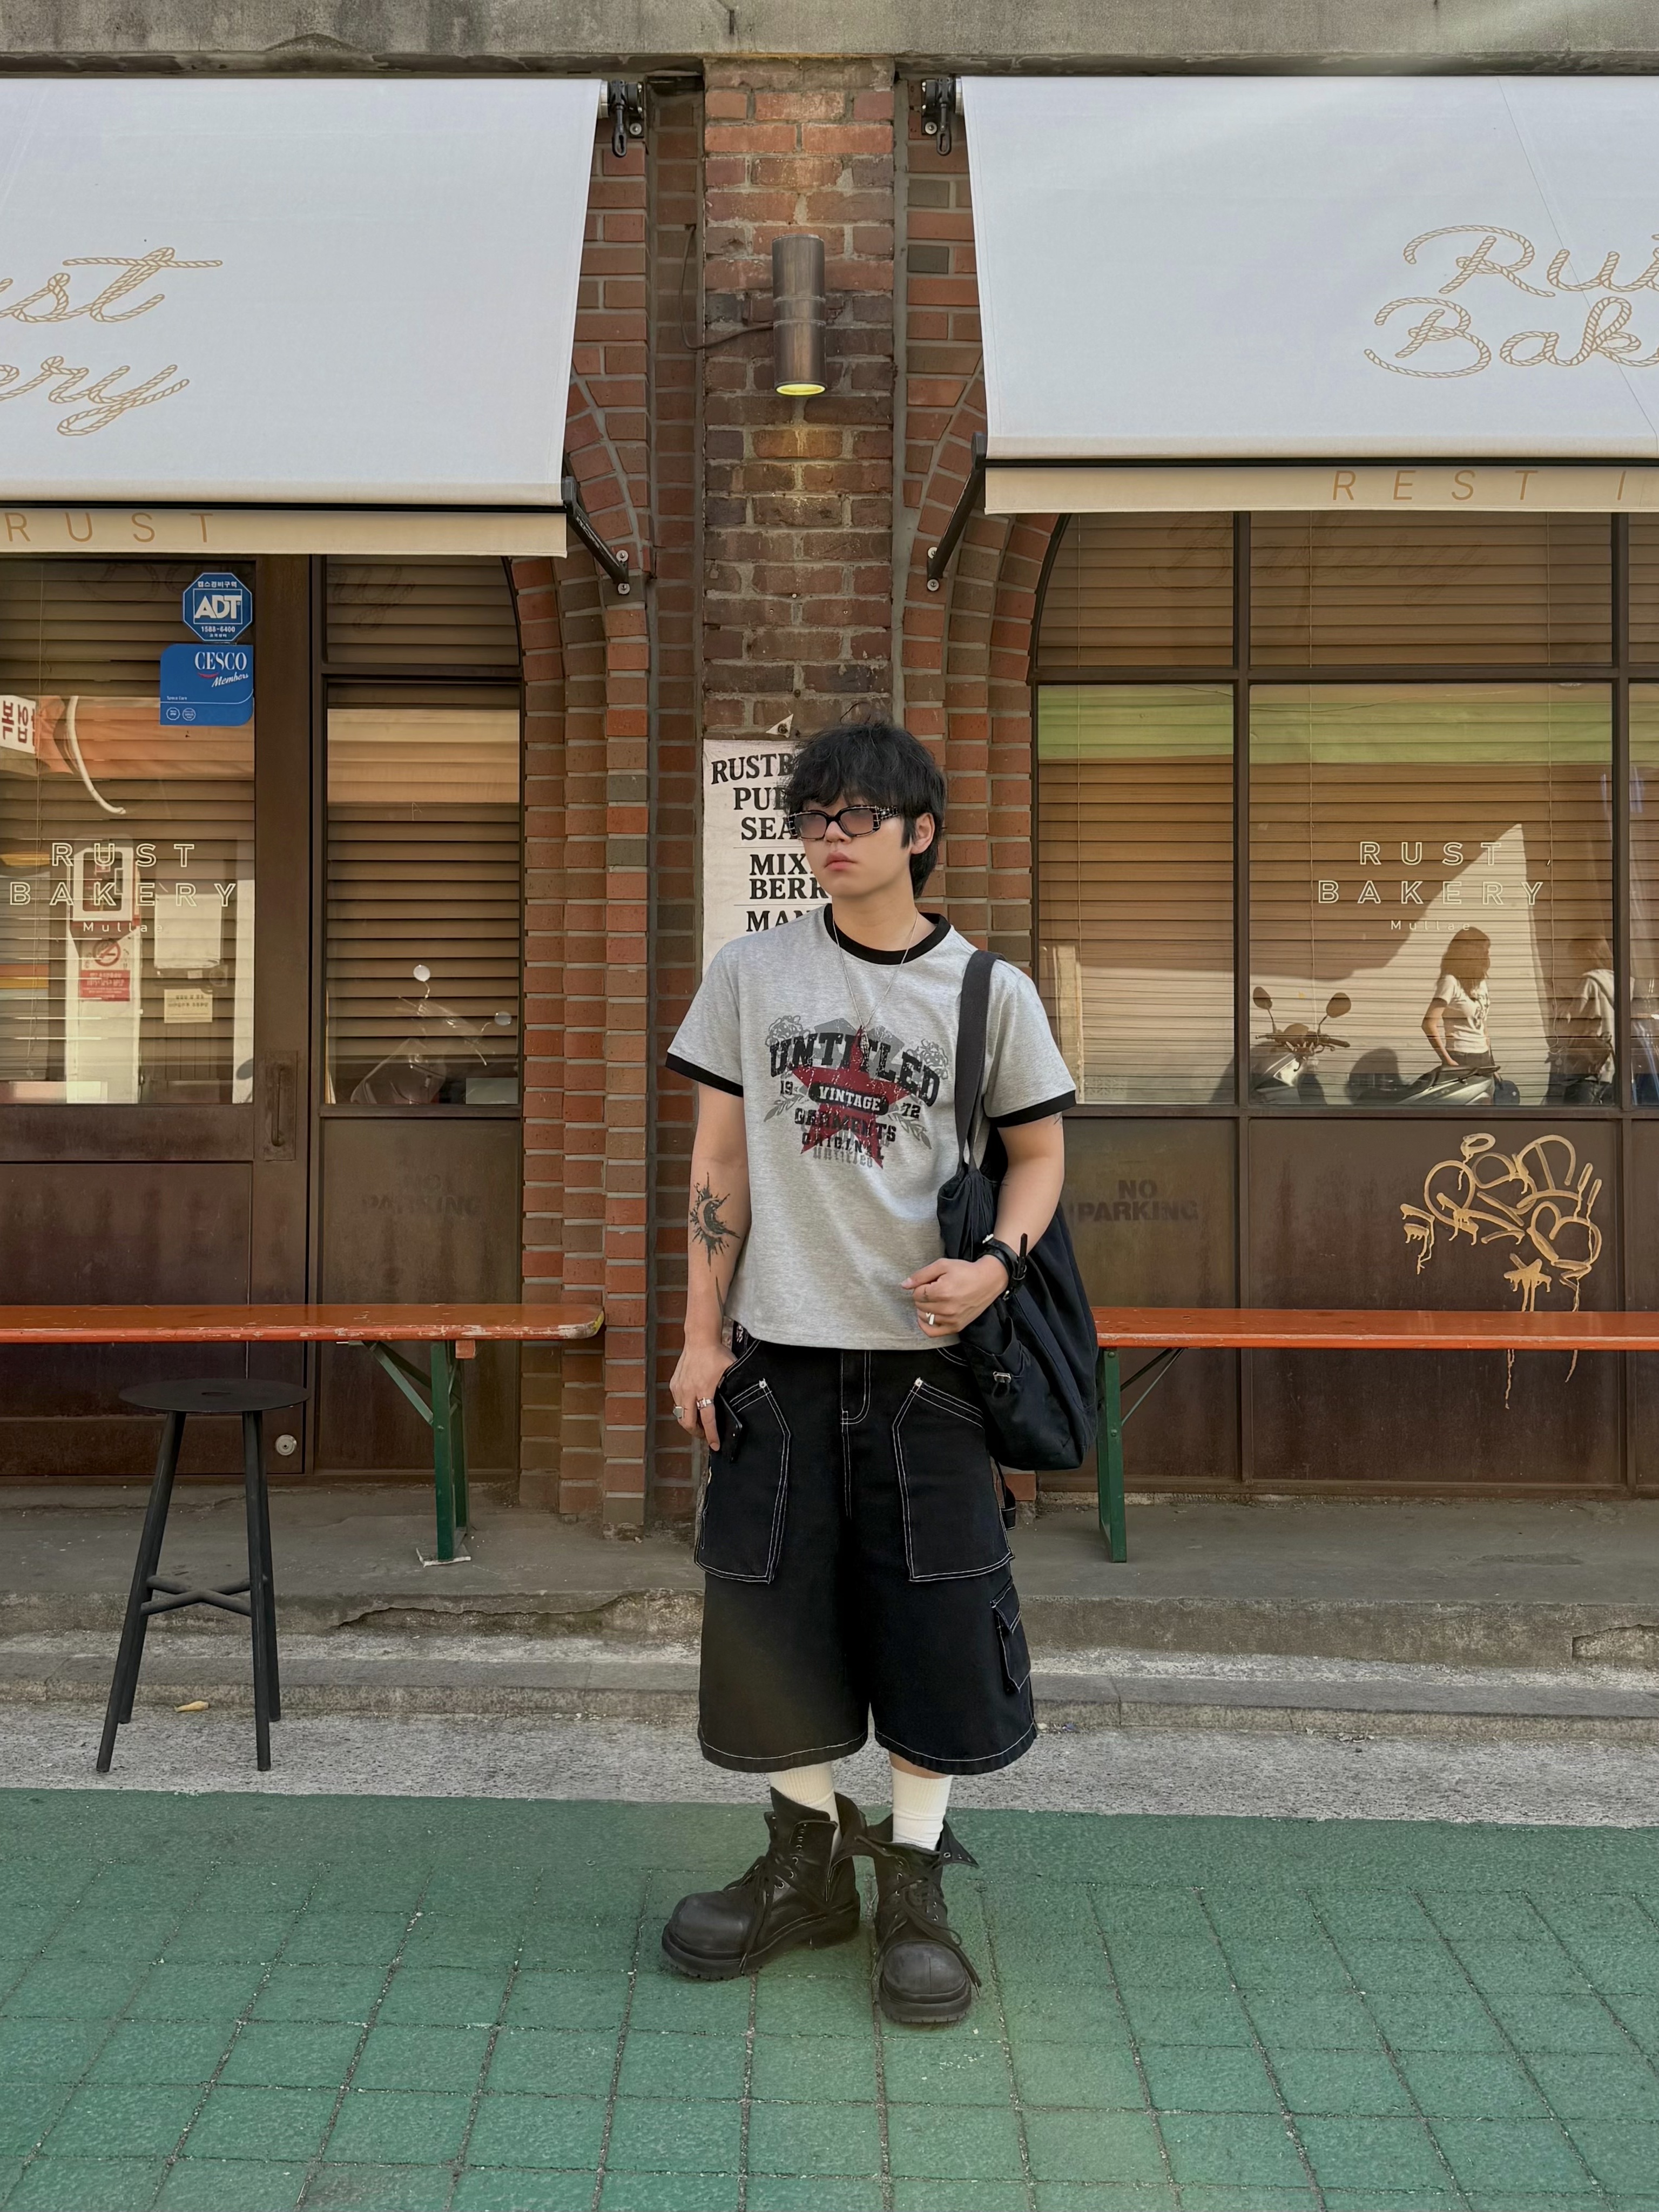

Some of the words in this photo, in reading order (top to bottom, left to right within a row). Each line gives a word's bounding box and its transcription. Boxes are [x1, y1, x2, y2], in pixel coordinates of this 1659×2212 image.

[1332, 470, 1539, 501] REST
[4, 512, 213, 543] RUST
[194, 595, 241, 619] ADT
[194, 651, 247, 670] CESCO
[211, 671, 248, 688] Members
[51, 843, 195, 868] RUST
[1360, 842, 1501, 866] RUST
[9, 882, 237, 907] BAKERY
[1318, 880, 1543, 905] BAKERY
[83, 922, 163, 933] Mullae
[1391, 920, 1470, 931] Mullae
[819, 1086, 881, 1111] VINTAGE
[1118, 1180, 1158, 1199] NO
[1078, 1201, 1199, 1221] PARKING
